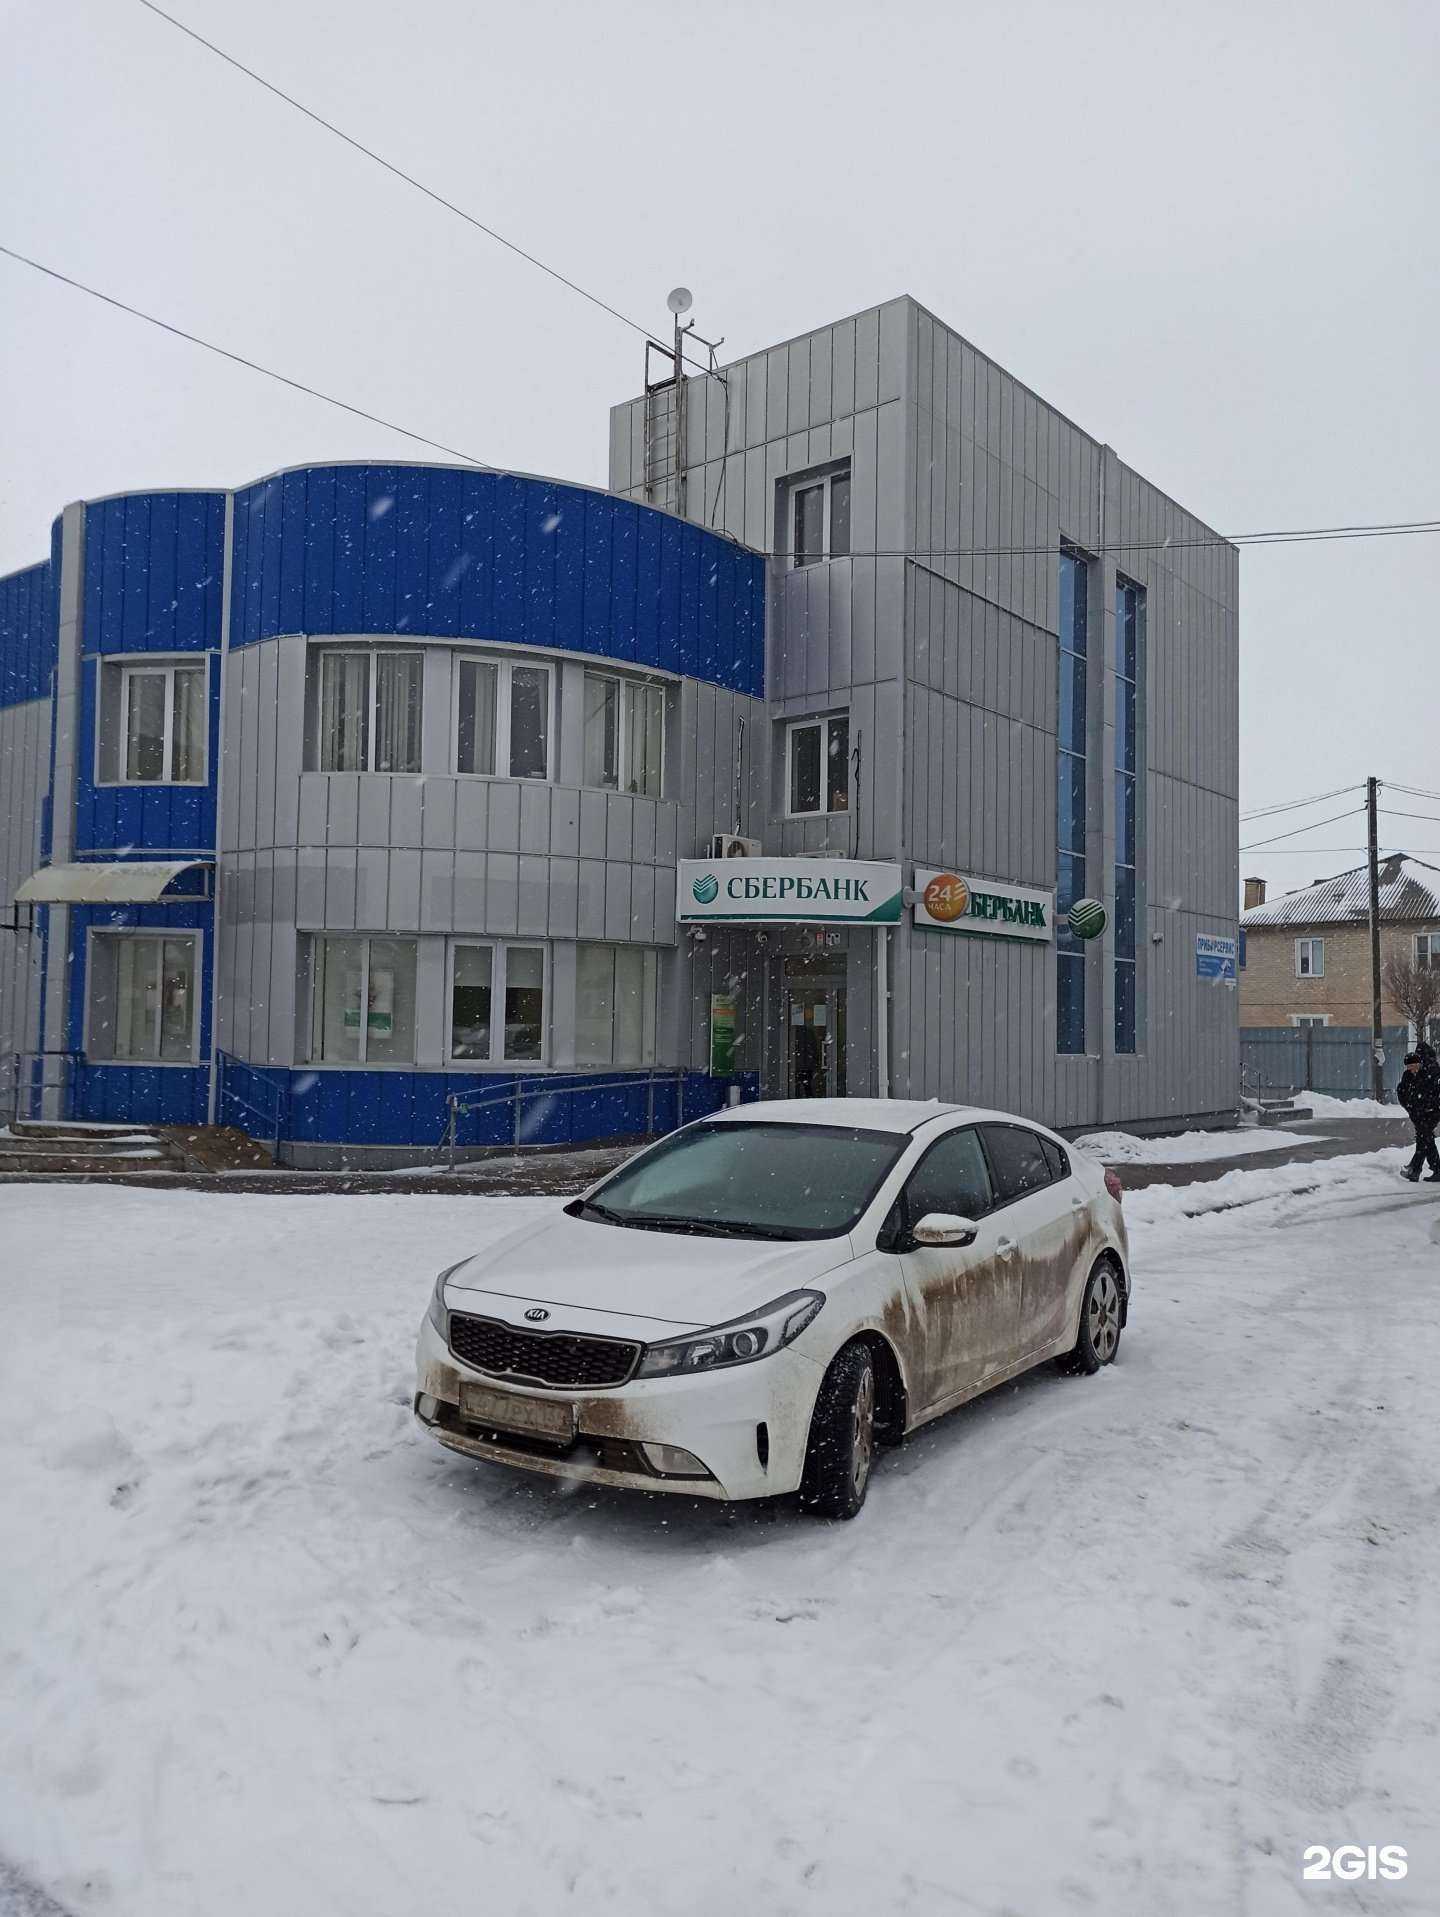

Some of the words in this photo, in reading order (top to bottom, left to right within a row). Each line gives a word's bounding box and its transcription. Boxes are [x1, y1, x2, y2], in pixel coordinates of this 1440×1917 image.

[727, 877, 870, 902] СБЕРБАНК
[928, 885, 953, 902] 24
[928, 903, 952, 912] ЧАСА
[968, 892, 1046, 926] БЕРБАНК
[527, 1308, 545, 1319] KIA
